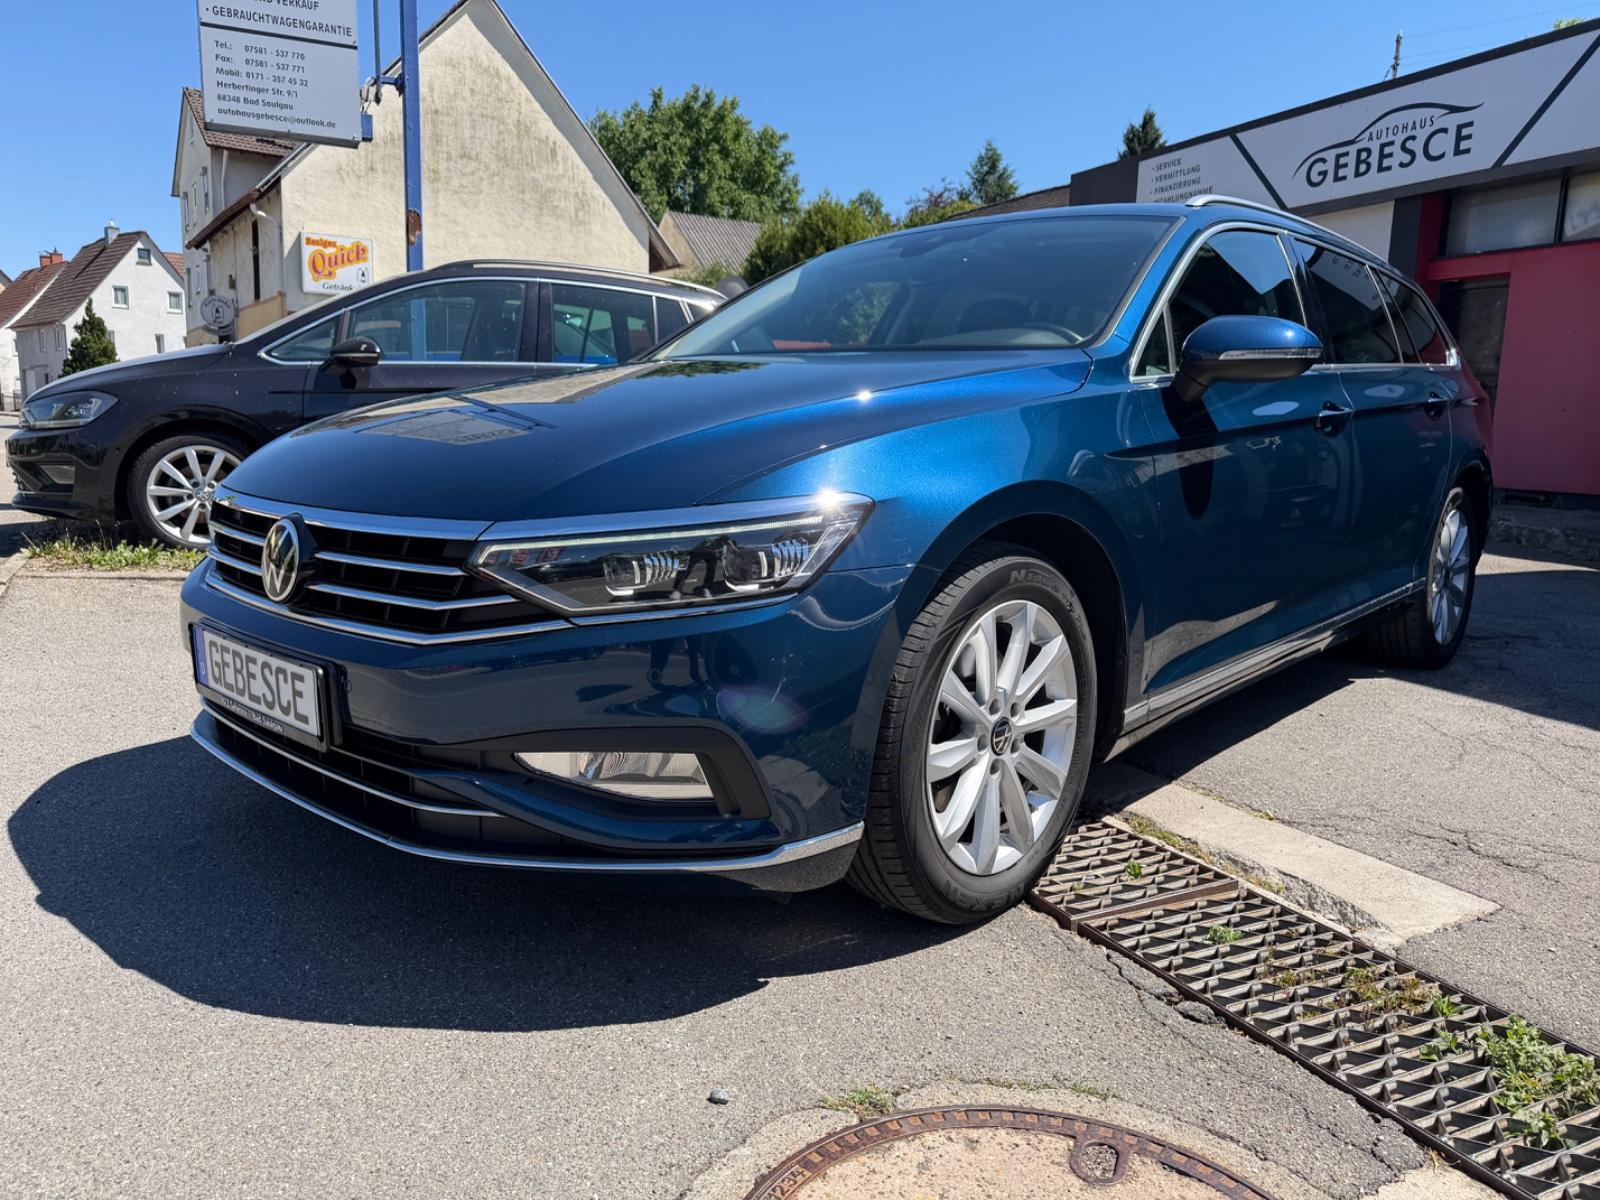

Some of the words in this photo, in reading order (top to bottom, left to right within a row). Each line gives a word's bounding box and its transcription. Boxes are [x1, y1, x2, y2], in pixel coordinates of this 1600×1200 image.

[276, 0, 319, 11] VERKAUF
[212, 5, 352, 37] GEBRAUCHTWAGENGARANTIE
[214, 40, 233, 50] Tel.:
[244, 45, 267, 55] 07581
[275, 49, 289, 58] 537
[291, 51, 306, 61] 770
[215, 53, 233, 63] Fax:
[245, 58, 268, 68] 07581
[276, 62, 289, 72] 537
[292, 64, 305, 73] 771
[216, 67, 242, 78] Mobil:
[245, 71, 264, 81] 0171
[272, 75, 286, 84] 357
[288, 77, 297, 86] 45
[299, 79, 309, 88] 32
[216, 80, 270, 95] Herbertinger
[271, 87, 285, 97] Str.
[286, 89, 298, 98] 9/1
[216, 93, 241, 104] 88348
[243, 96, 260, 106] Bad
[261, 98, 294, 111] Saulgau
[217, 107, 337, 129] autohausgebesce@outlook.de
[1367, 116, 1435, 143] AUTOHAUS
[1155, 157, 1182, 172] SERVICE
[1305, 120, 1474, 188] GEBESCE
[1154, 164, 1201, 183] VERMITTLUNG
[1154, 176, 1201, 194] FINANZIERUNG
[310, 243, 367, 278] Quick
[208, 639, 309, 726] GEBESCE
